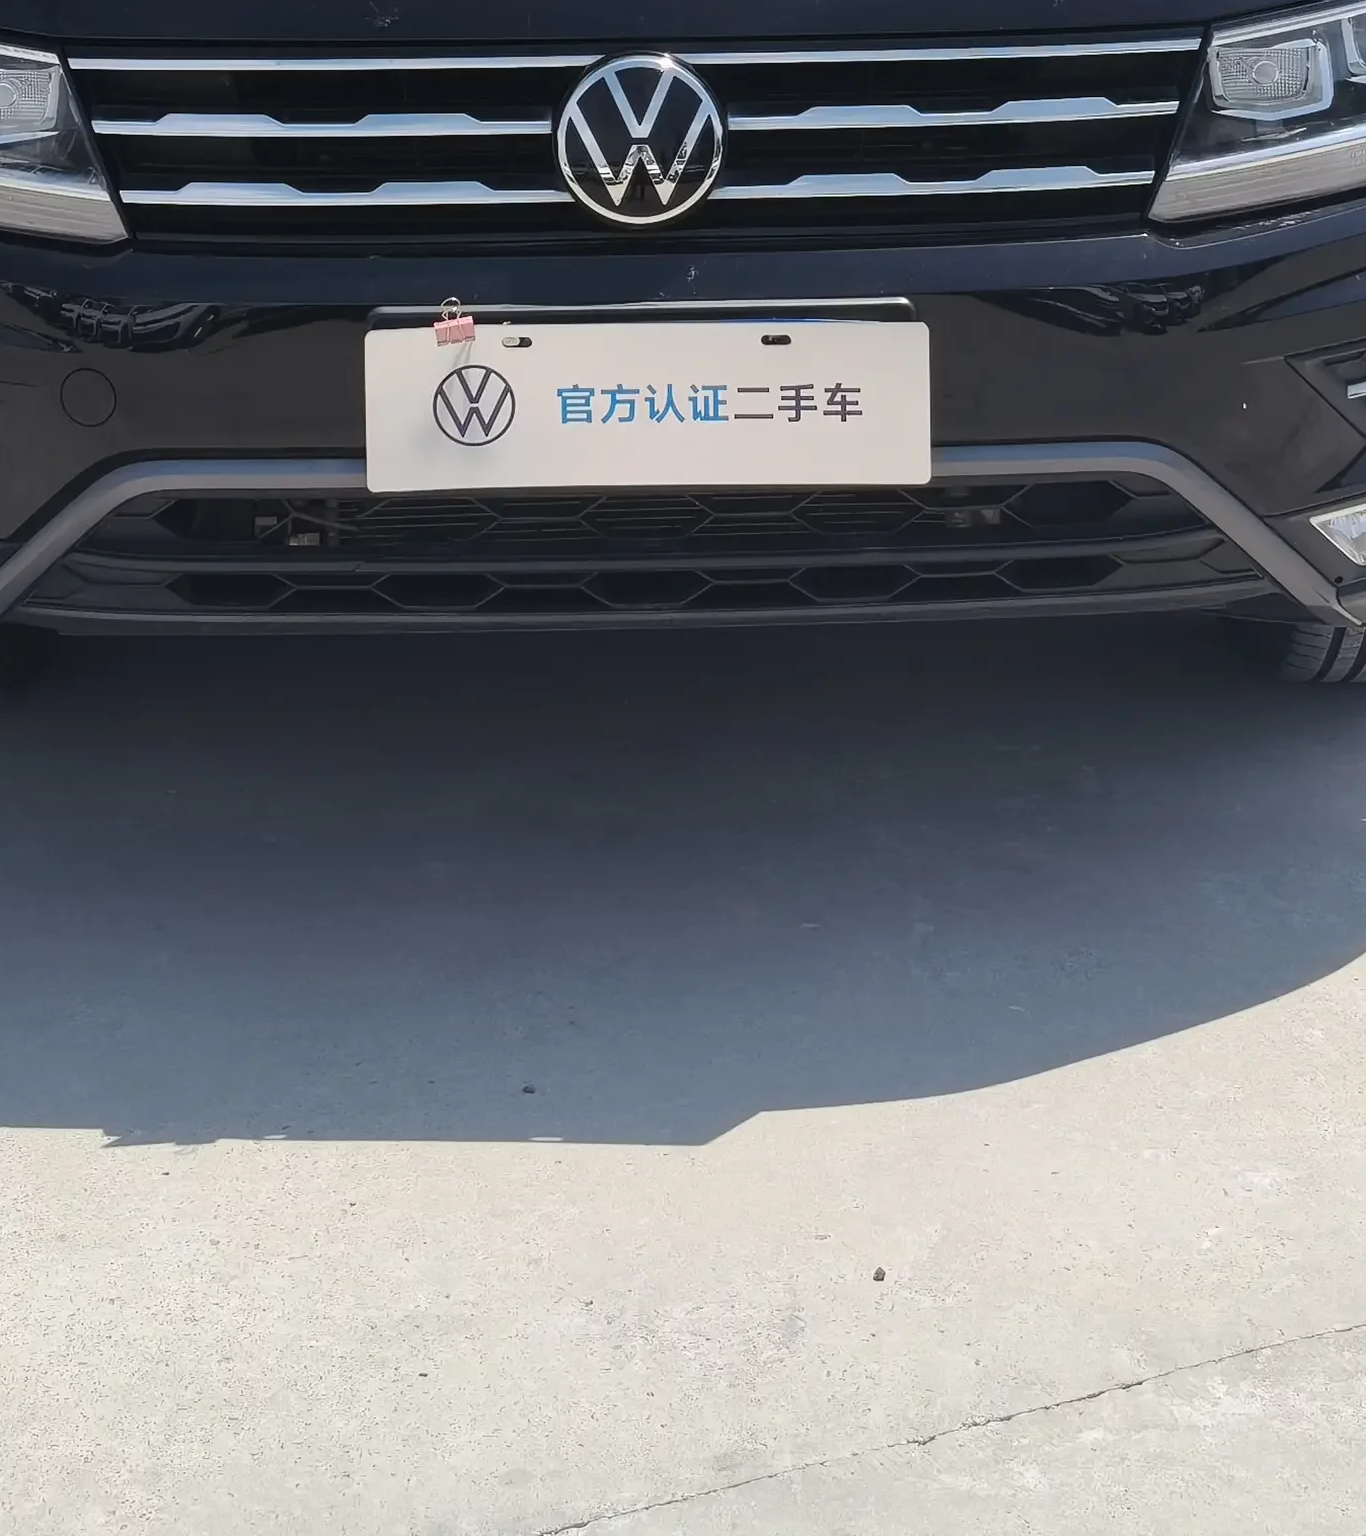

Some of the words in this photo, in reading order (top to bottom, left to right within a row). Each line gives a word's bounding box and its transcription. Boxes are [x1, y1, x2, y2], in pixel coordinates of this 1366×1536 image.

[556, 382, 864, 424] 官方认证二手车
